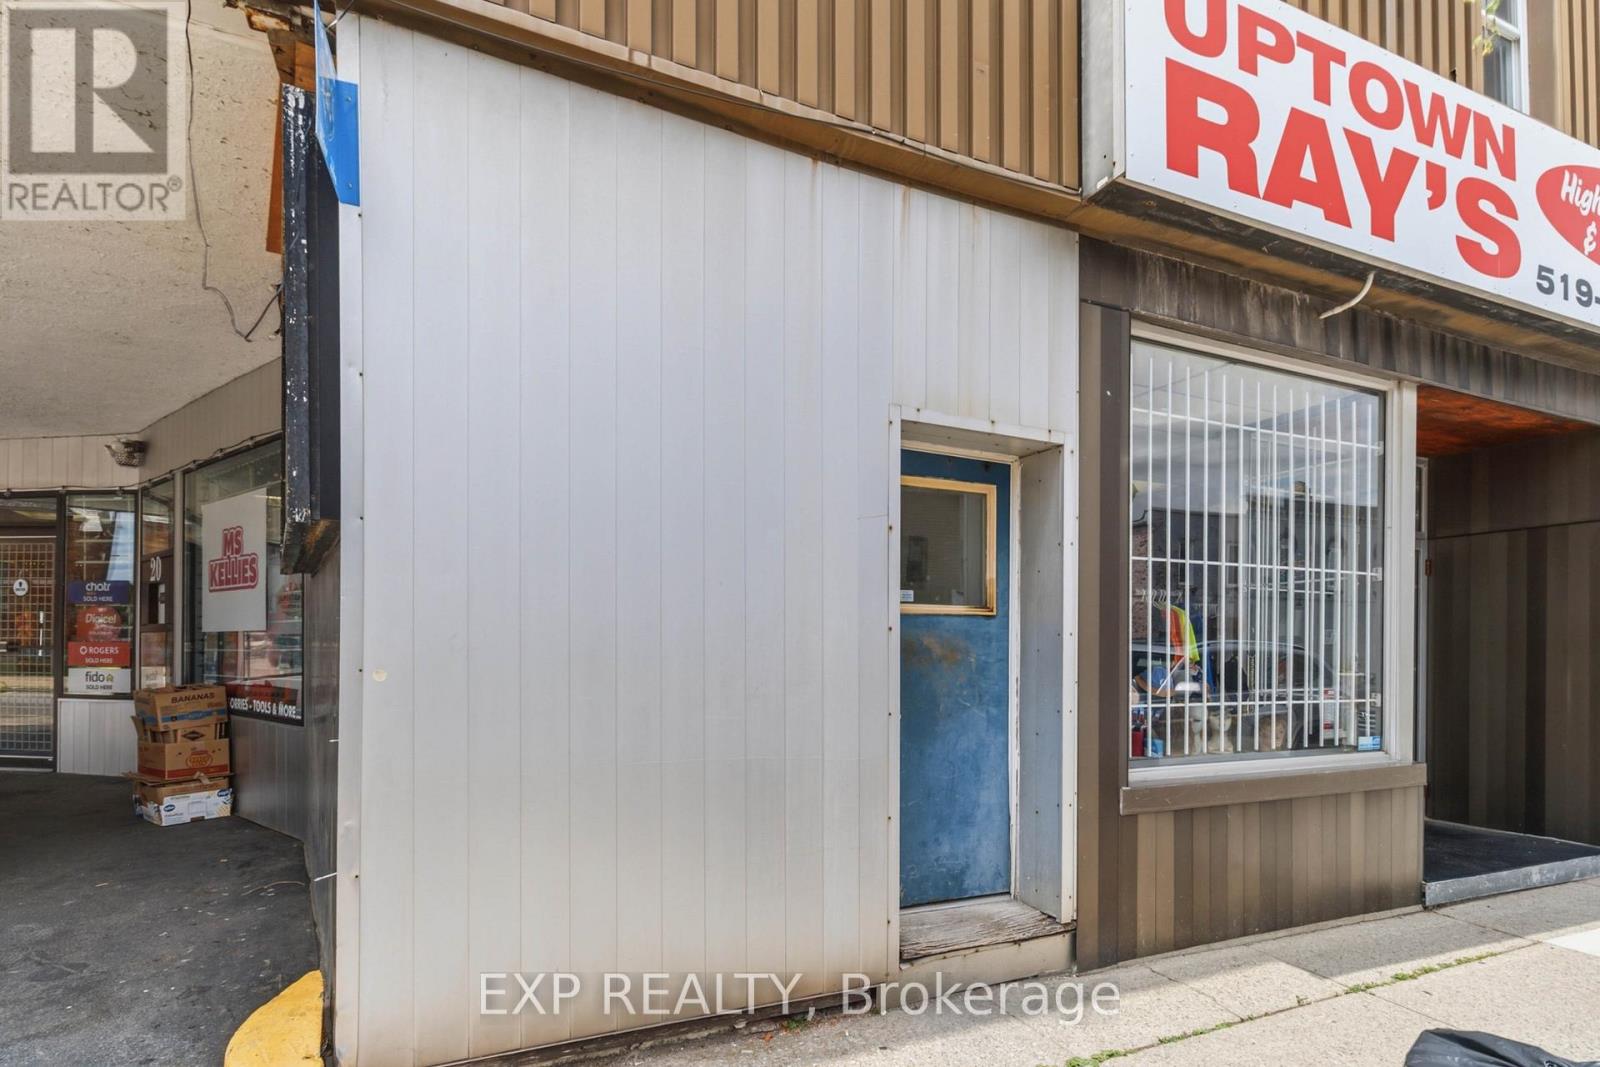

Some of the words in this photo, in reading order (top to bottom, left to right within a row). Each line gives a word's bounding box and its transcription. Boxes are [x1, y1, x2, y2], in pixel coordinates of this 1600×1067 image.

[1164, 0, 1516, 181] UPTOWN
[1165, 57, 1522, 279] RAY'S
[223, 526, 244, 558] MS
[150, 556, 162, 582] 20
[208, 553, 259, 592] KELLIES
[88, 646, 119, 655] ROGERS
[85, 671, 105, 682] fido
[171, 692, 215, 704] BANANAS
[253, 699, 271, 714] TOOLS
